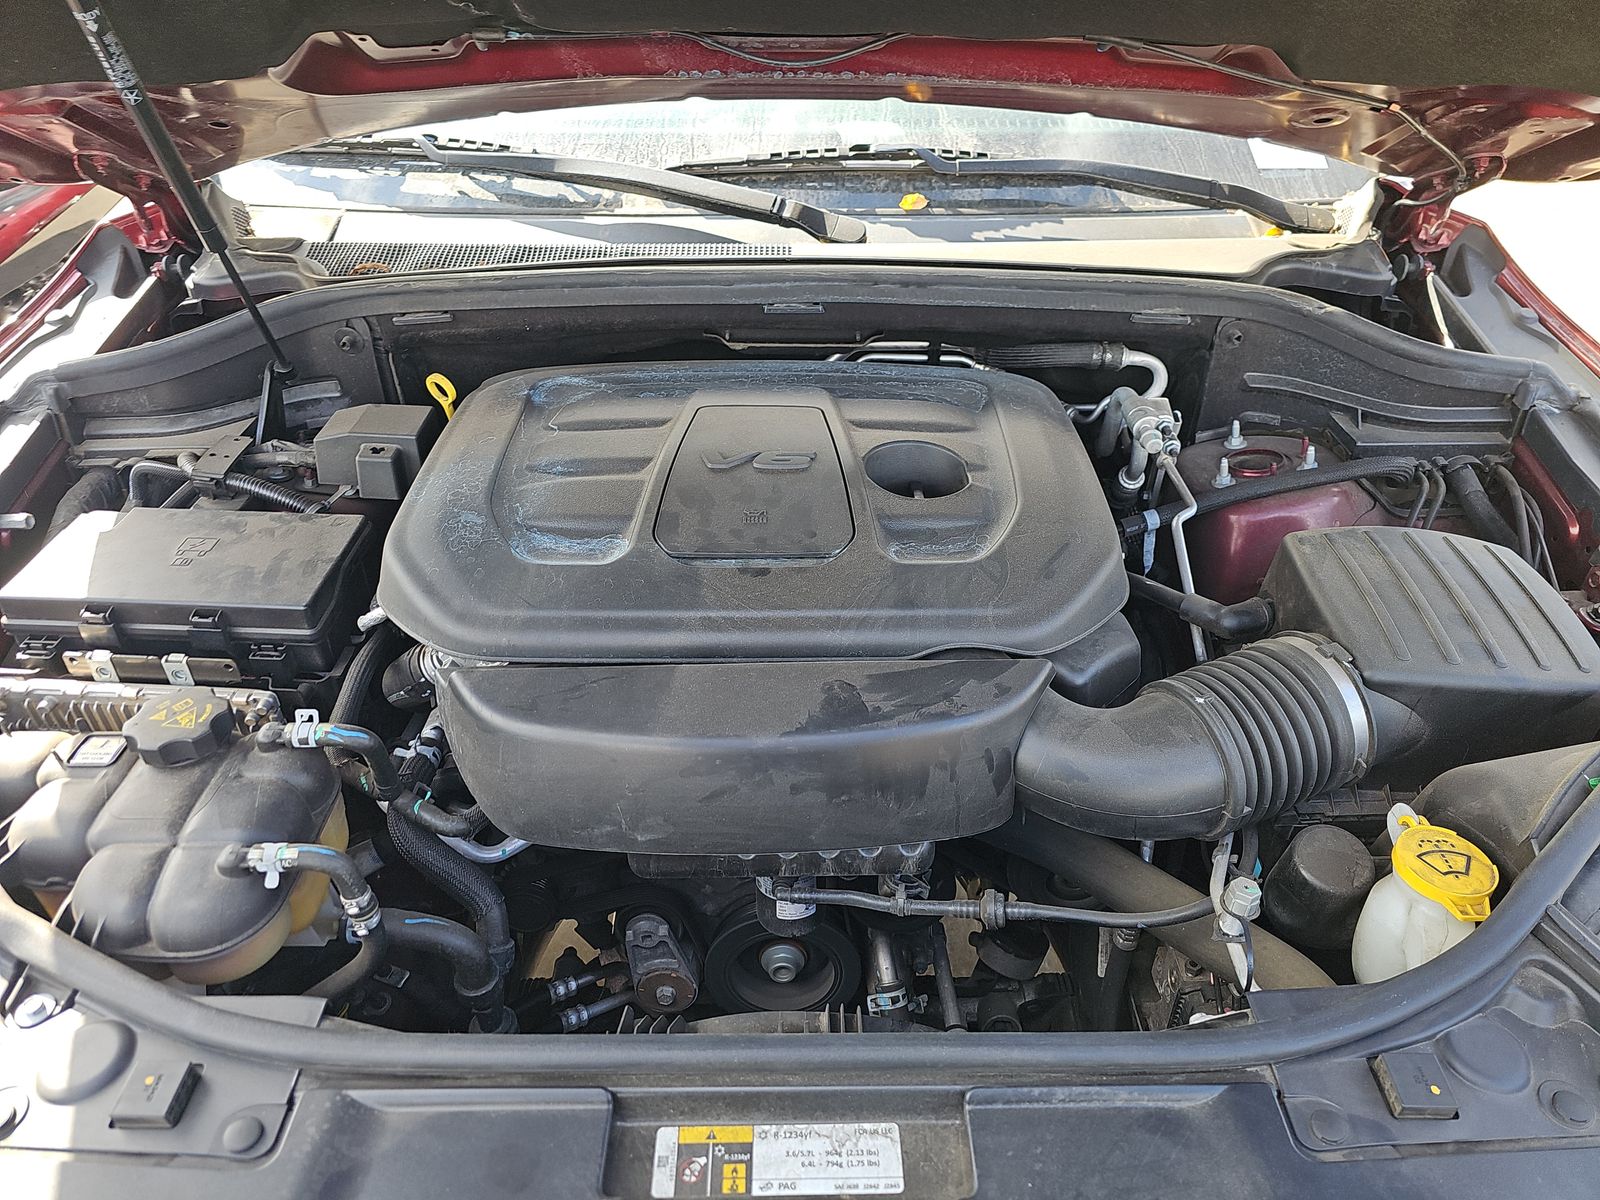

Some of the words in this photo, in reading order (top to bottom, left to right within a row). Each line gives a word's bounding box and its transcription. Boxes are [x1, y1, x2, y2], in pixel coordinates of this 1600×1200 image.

[700, 450, 817, 470] V6
[773, 1129, 812, 1141] R-1234yf
[881, 1126, 893, 1135] LLC
[785, 1150, 815, 1158] 3.6/5.7L
[846, 1149, 864, 1158] (2.13
[866, 1149, 880, 1157] lbs)
[825, 1160, 844, 1168] 794g
[846, 1160, 865, 1168] (1.75
[867, 1159, 881, 1168] lbs)
[778, 1182, 797, 1191] PAG
